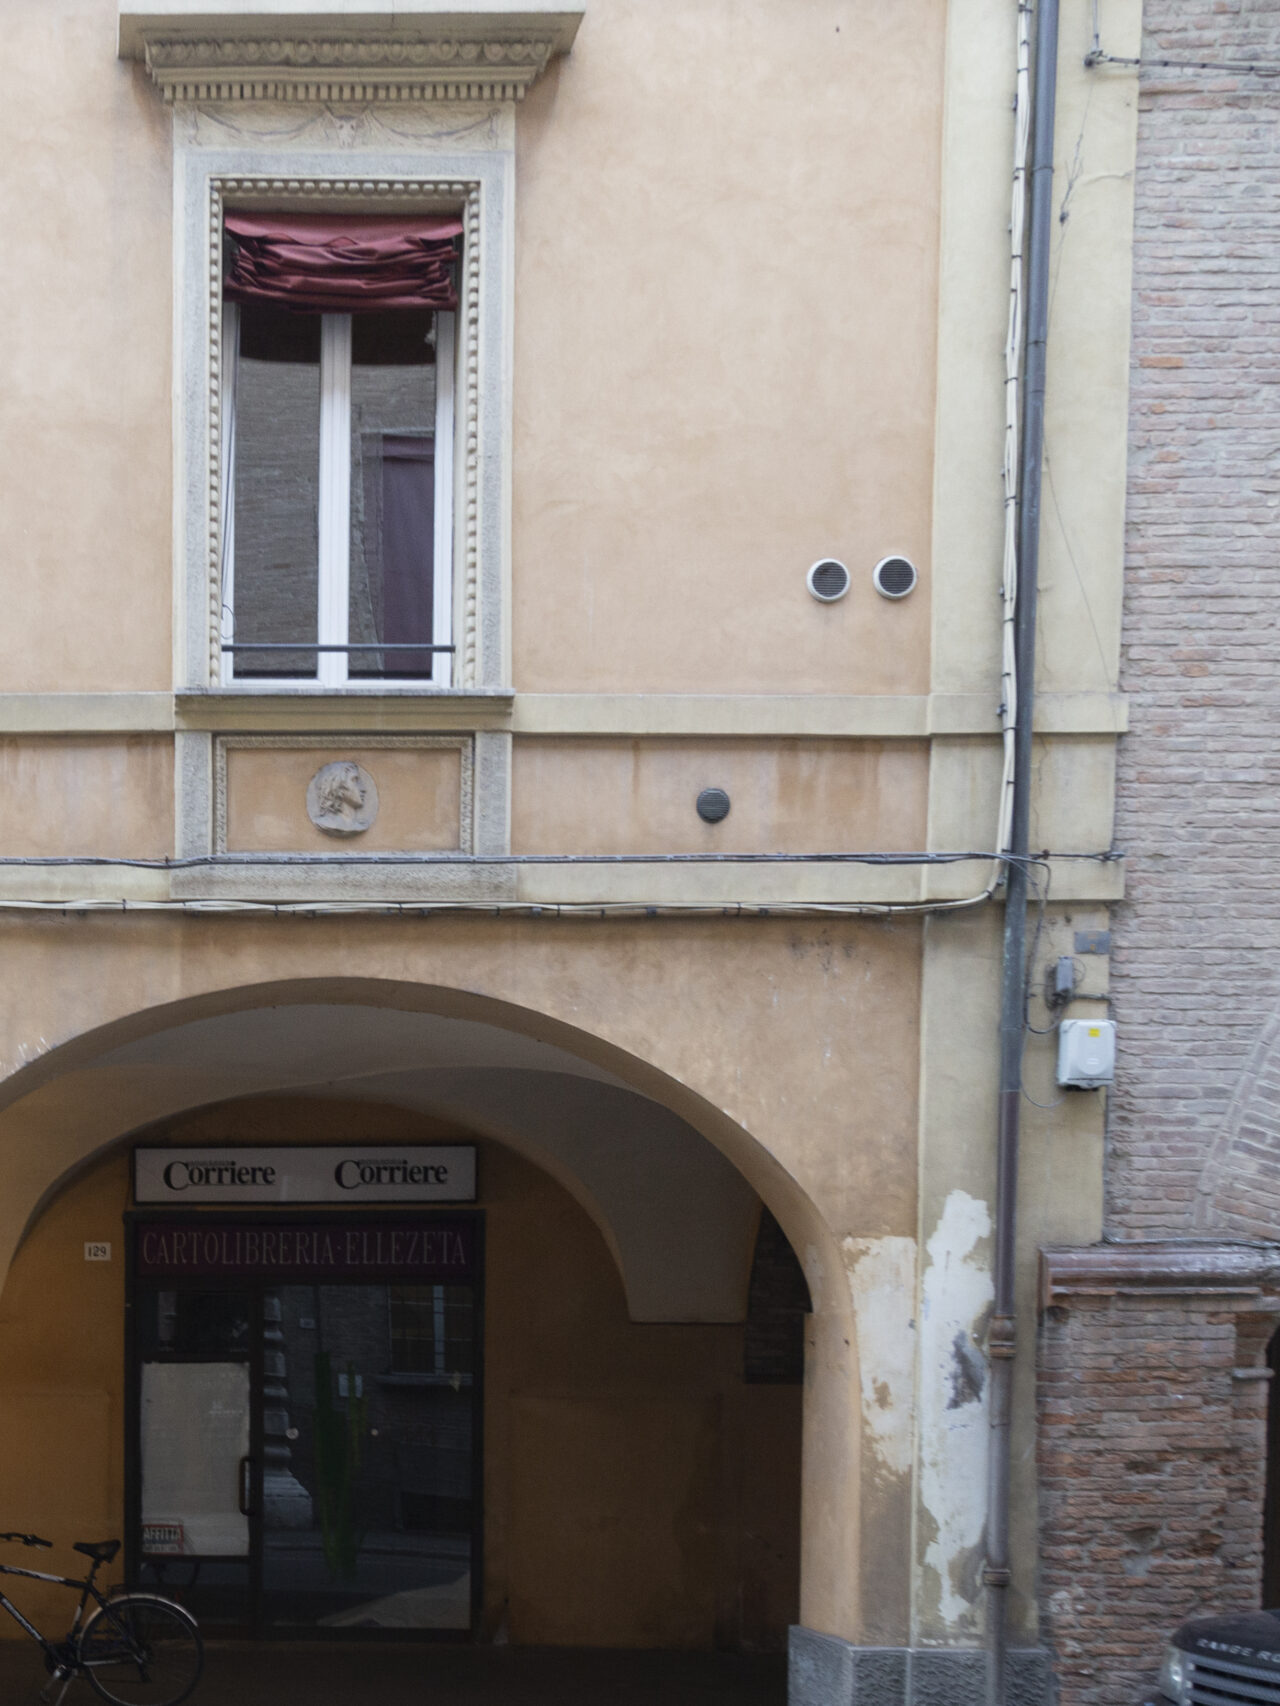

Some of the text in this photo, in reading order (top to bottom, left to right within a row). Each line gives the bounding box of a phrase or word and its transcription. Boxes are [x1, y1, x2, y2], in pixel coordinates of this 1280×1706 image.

[163, 1158, 449, 1191] Corriere Corriere
[87, 1244, 107, 1258] 129
[142, 1230, 467, 1266] CARTOLIBRERIA ELLEZETA
